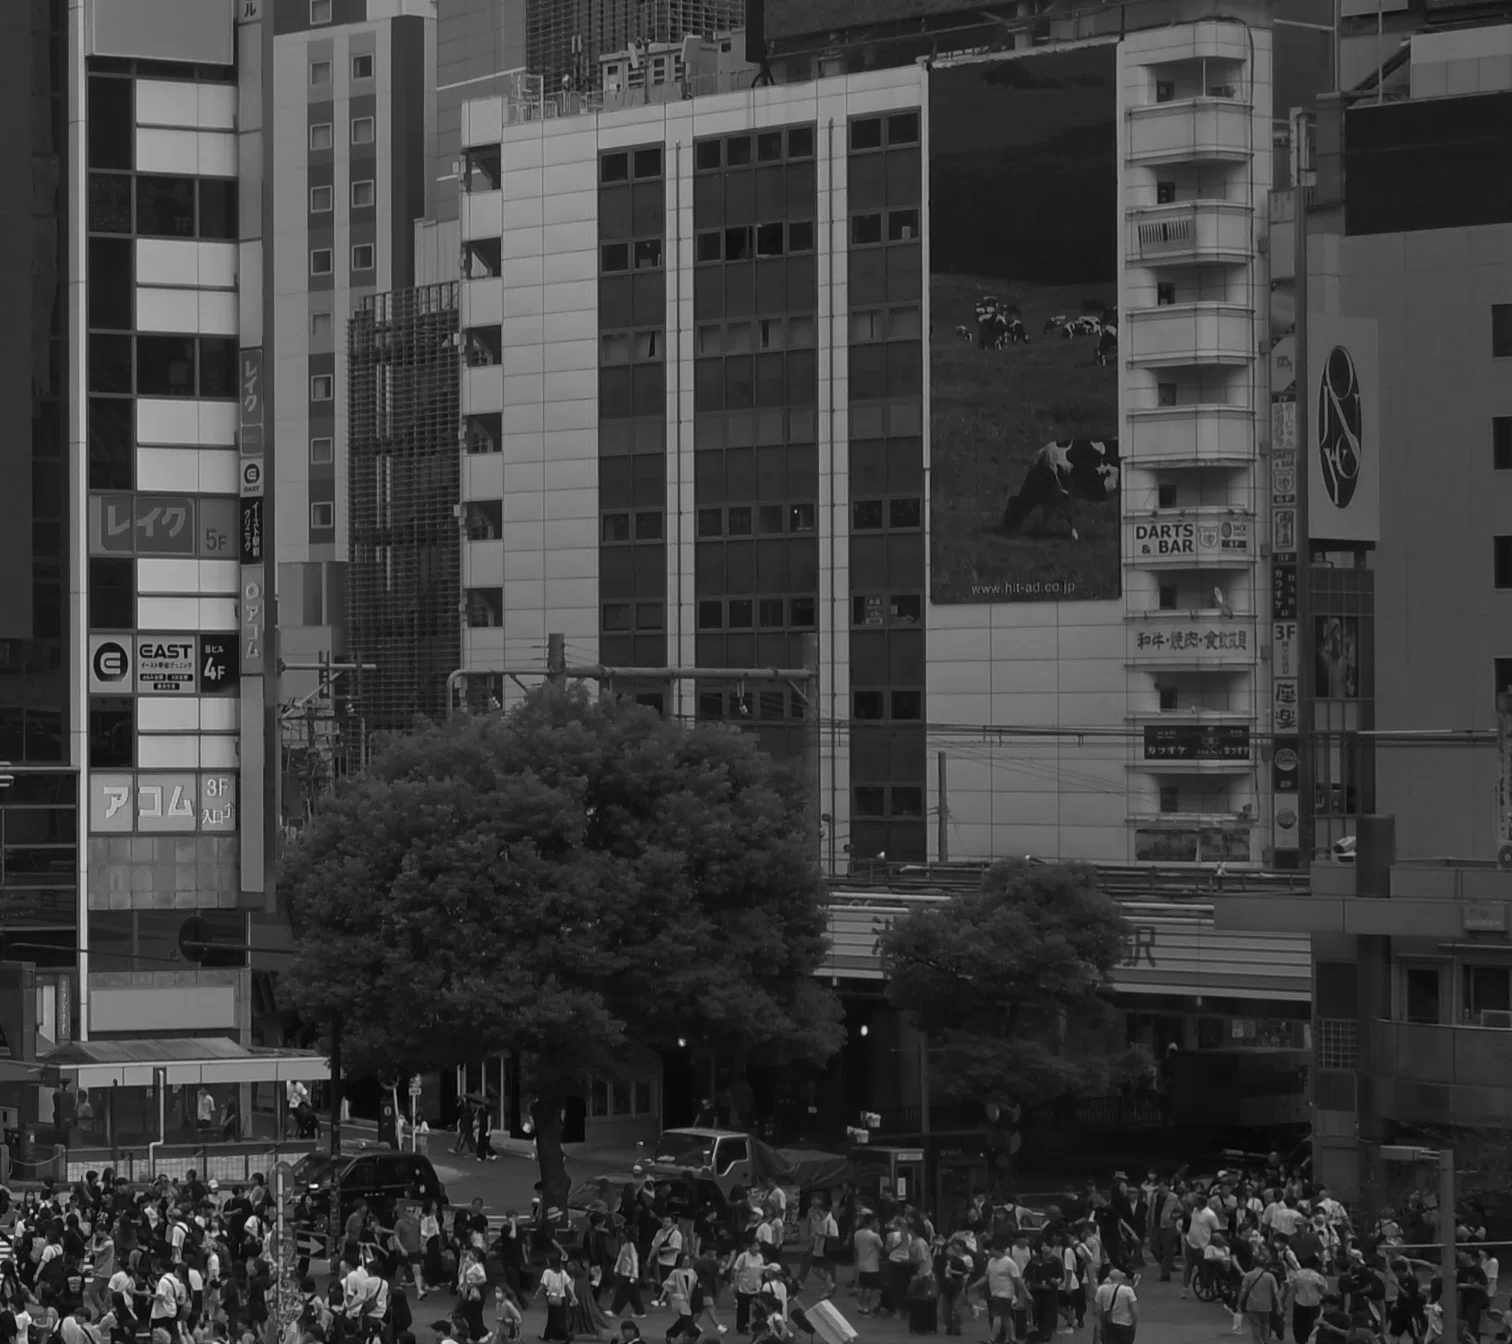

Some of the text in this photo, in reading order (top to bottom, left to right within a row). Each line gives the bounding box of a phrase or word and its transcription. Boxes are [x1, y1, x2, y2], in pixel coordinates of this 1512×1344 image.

[245, 359, 257, 412] レイク
[105, 503, 187, 542] レイク
[1136, 524, 1194, 540] DARTS
[206, 528, 228, 550] 5F
[1158, 539, 1194, 554] BAR
[246, 605, 259, 659] アコム
[1275, 625, 1296, 640] 3F
[140, 644, 193, 659] EAST
[203, 656, 226, 681] 4F
[206, 778, 229, 797] 3F
[103, 785, 193, 819] アコム
